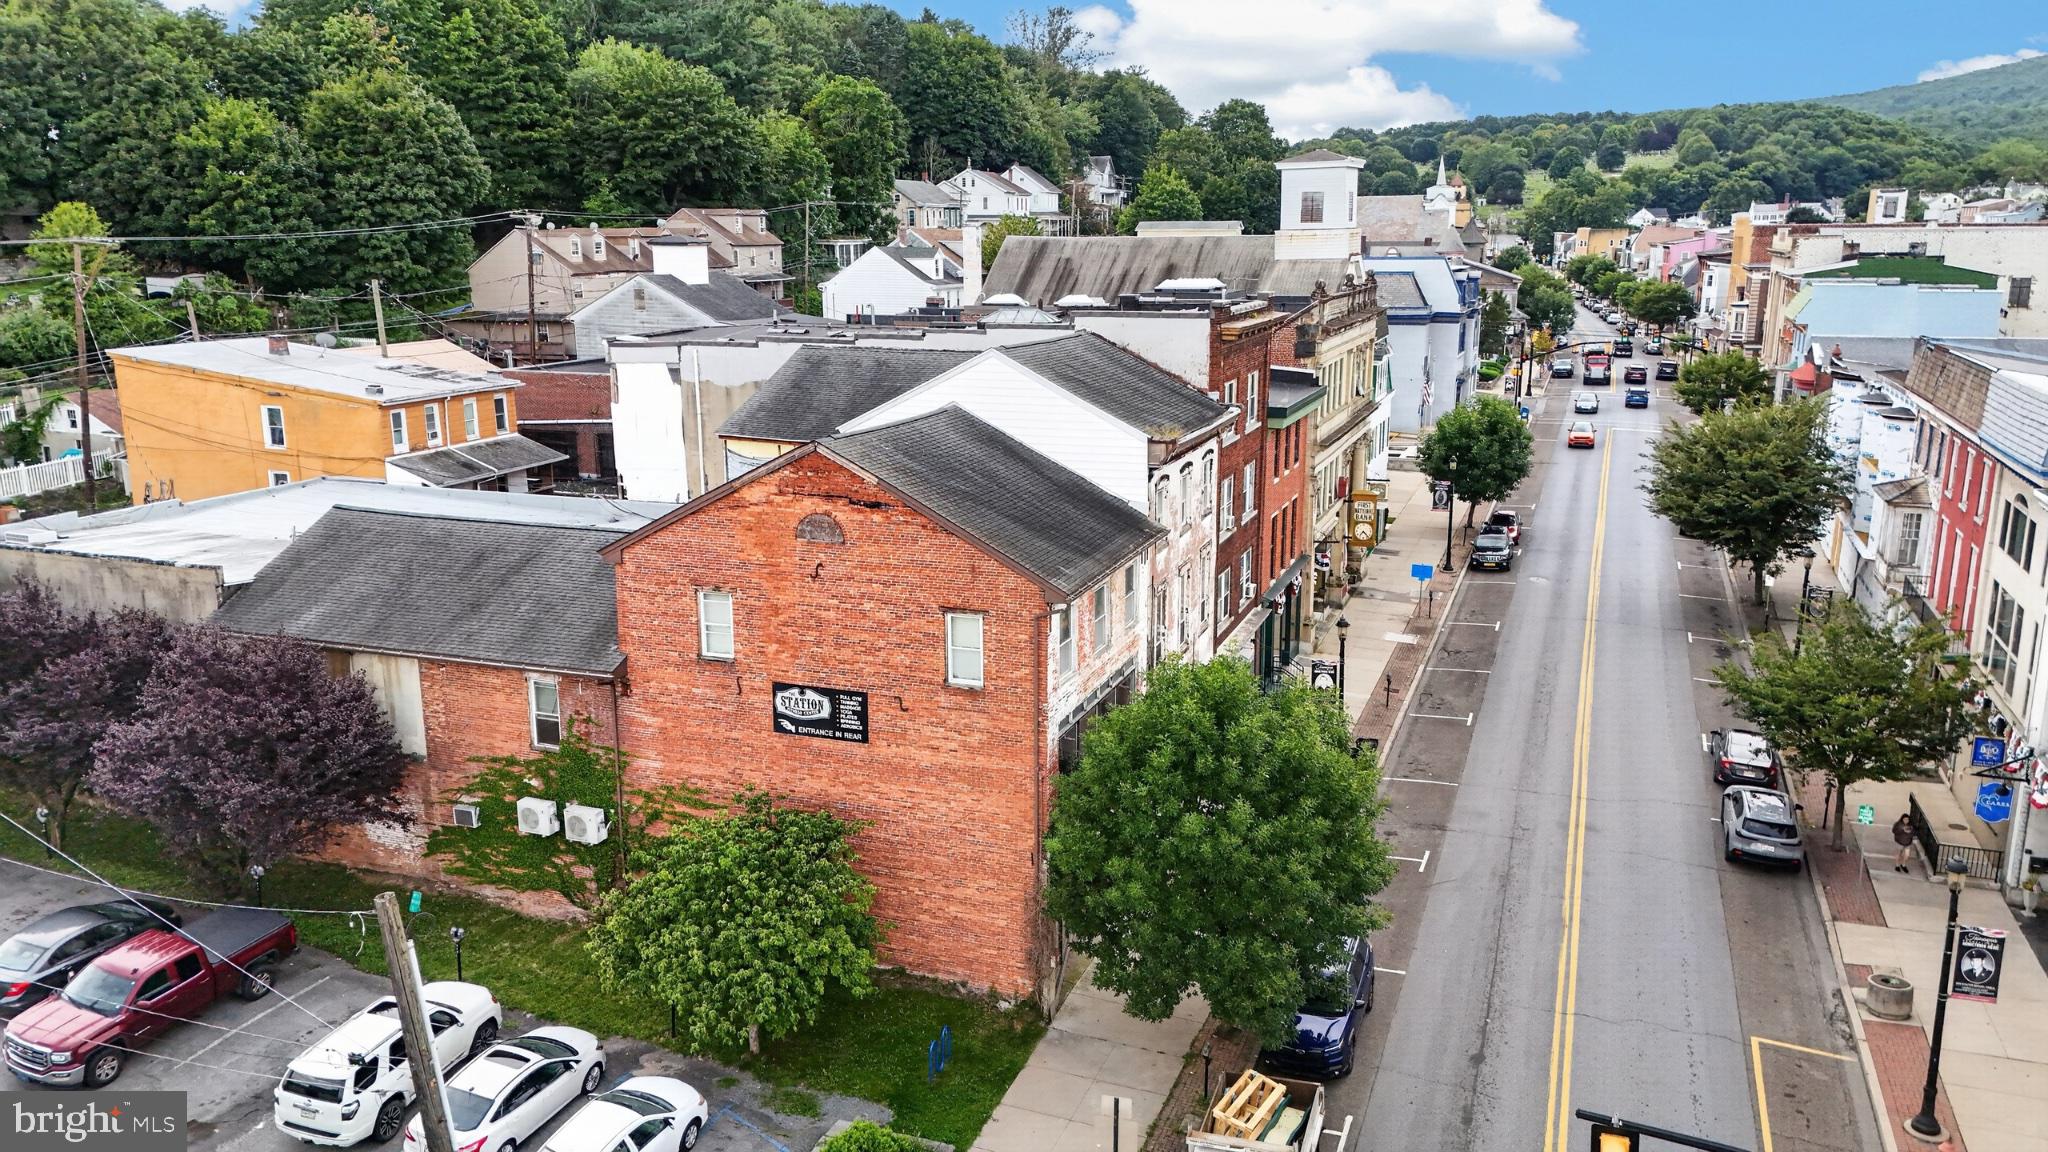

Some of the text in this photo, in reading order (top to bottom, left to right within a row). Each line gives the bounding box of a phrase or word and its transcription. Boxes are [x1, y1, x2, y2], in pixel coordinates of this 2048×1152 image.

[780, 695, 824, 711] STATION
[798, 726, 834, 737] ENTRANCE
[844, 732, 862, 740] REAR
